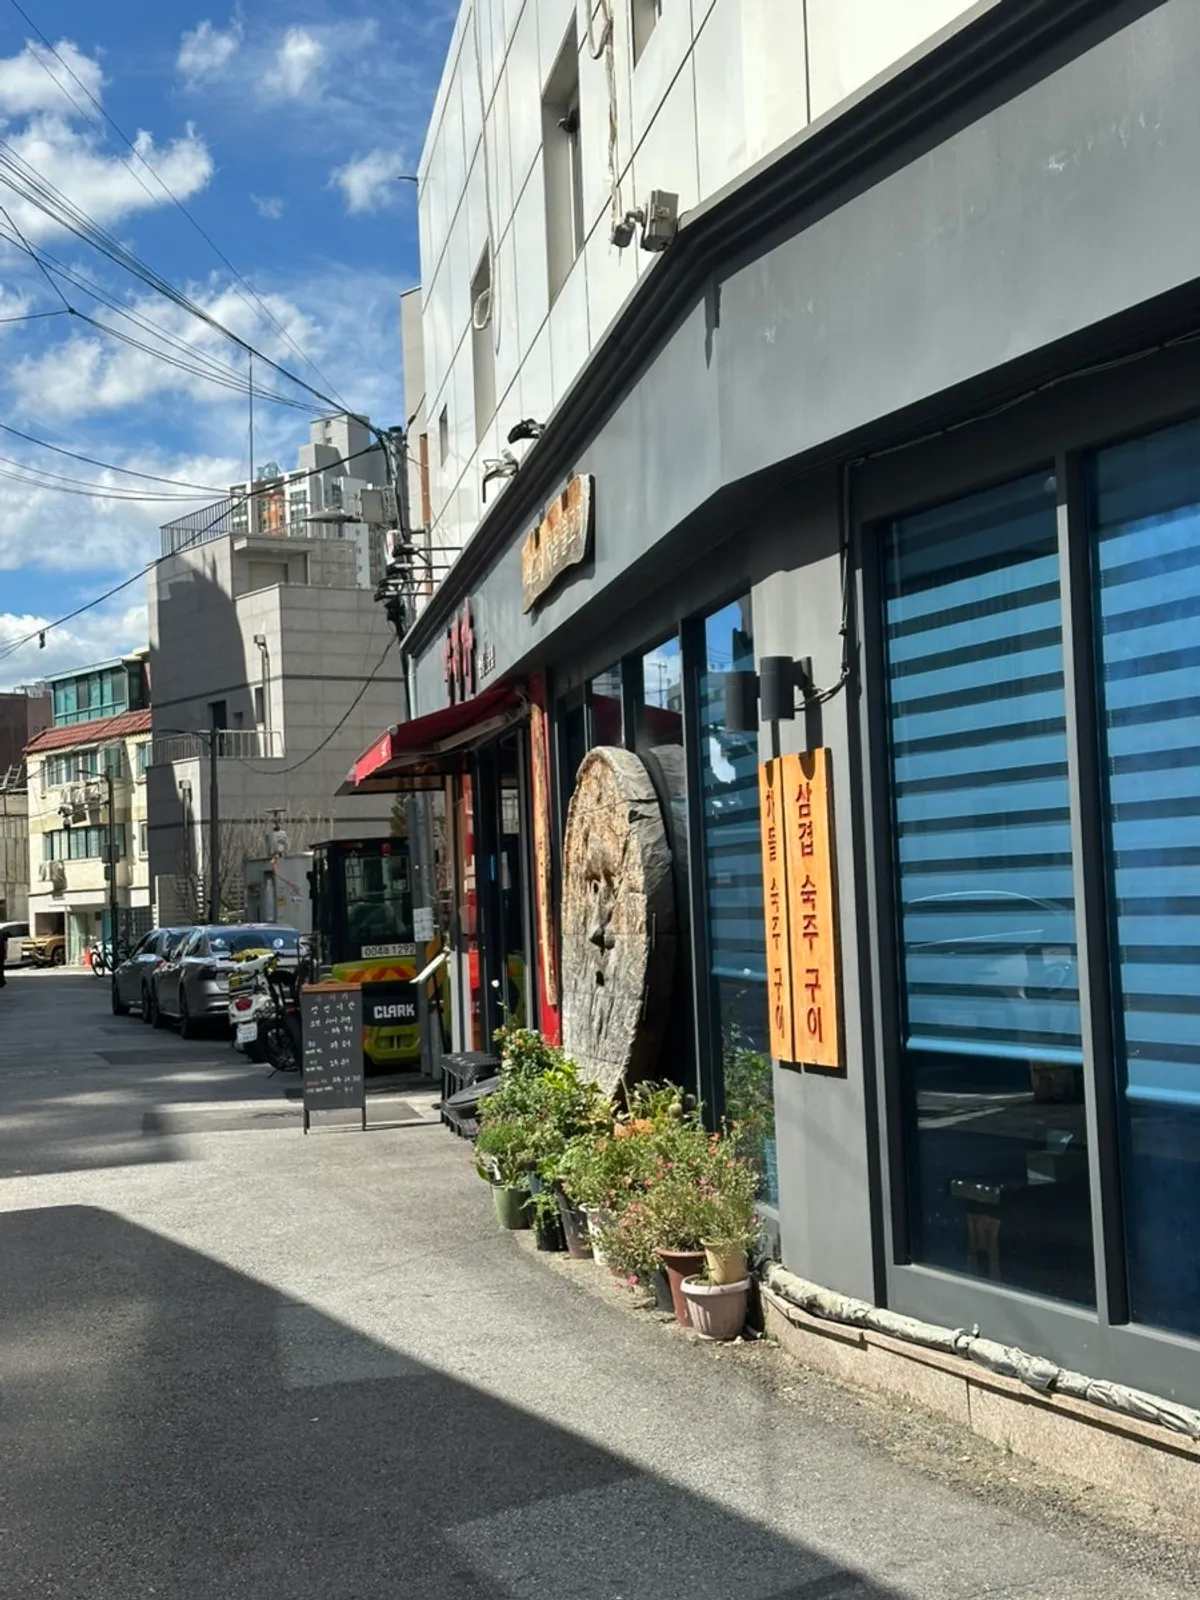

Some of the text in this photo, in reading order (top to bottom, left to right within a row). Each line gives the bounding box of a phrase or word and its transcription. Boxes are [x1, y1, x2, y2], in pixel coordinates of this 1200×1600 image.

[795, 781, 823, 1043] 삼겹 숙주 구이
[373, 1003, 415, 1019] CLARK
[774, 968, 785, 1039] 구이
